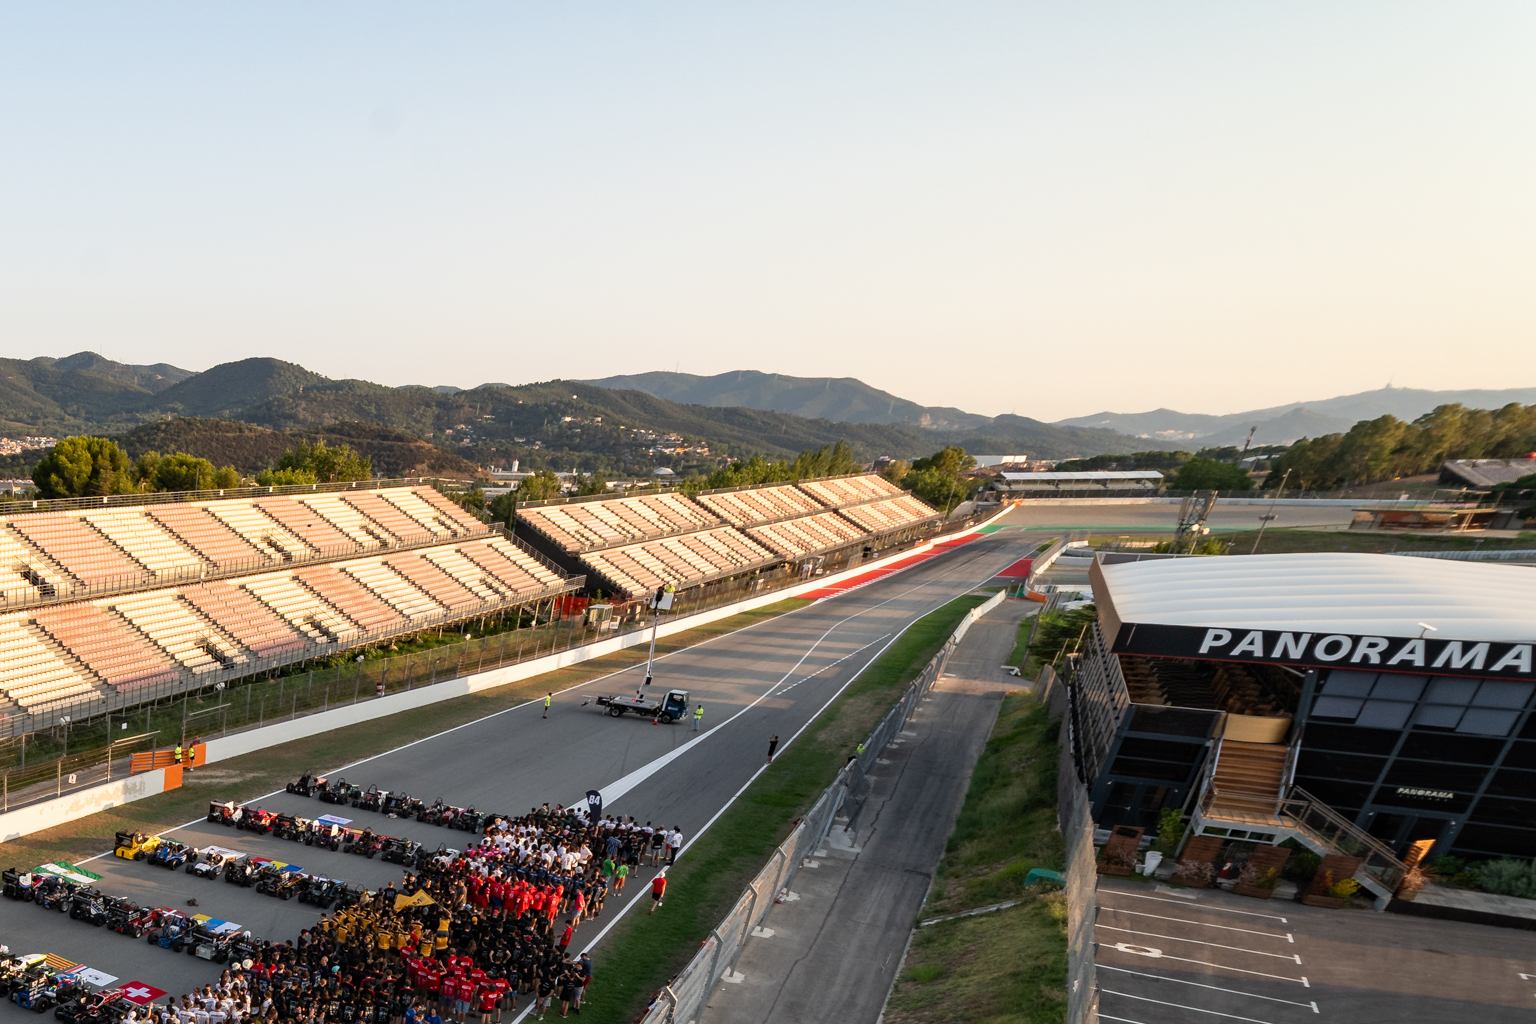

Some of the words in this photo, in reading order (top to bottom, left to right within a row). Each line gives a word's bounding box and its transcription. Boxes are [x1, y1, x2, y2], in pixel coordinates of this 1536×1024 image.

[1198, 628, 1533, 673] PANORAMA
[1396, 787, 1454, 799] PANORAMA
[589, 794, 601, 805] 84
